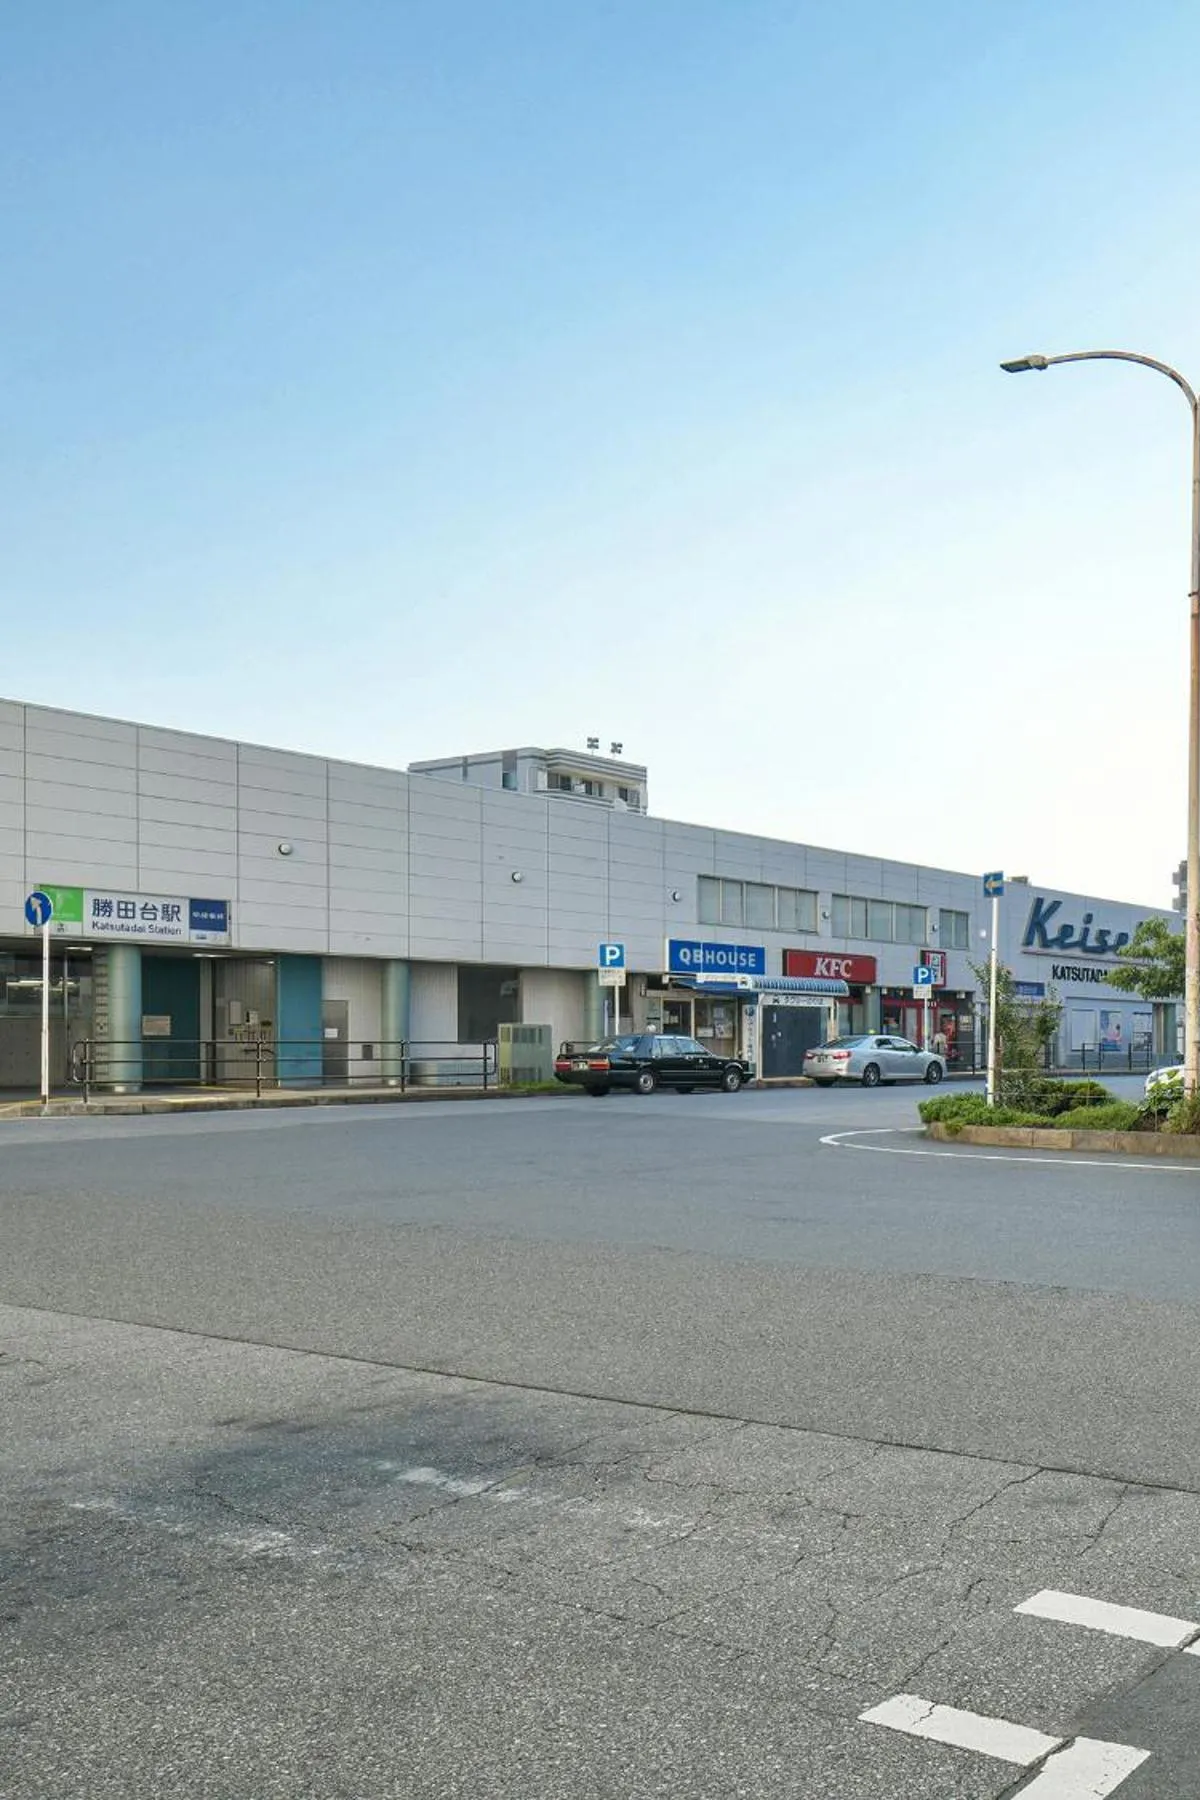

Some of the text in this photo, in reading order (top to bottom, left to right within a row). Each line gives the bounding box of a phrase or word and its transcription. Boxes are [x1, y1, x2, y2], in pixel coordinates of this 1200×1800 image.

[92, 898, 182, 923] 勝田台駅
[91, 920, 182, 936] Katsutadai Station
[1022, 897, 1143, 955] Keise
[605, 945, 621, 966] P
[814, 957, 853, 978] KFC
[918, 968, 929, 983] P
